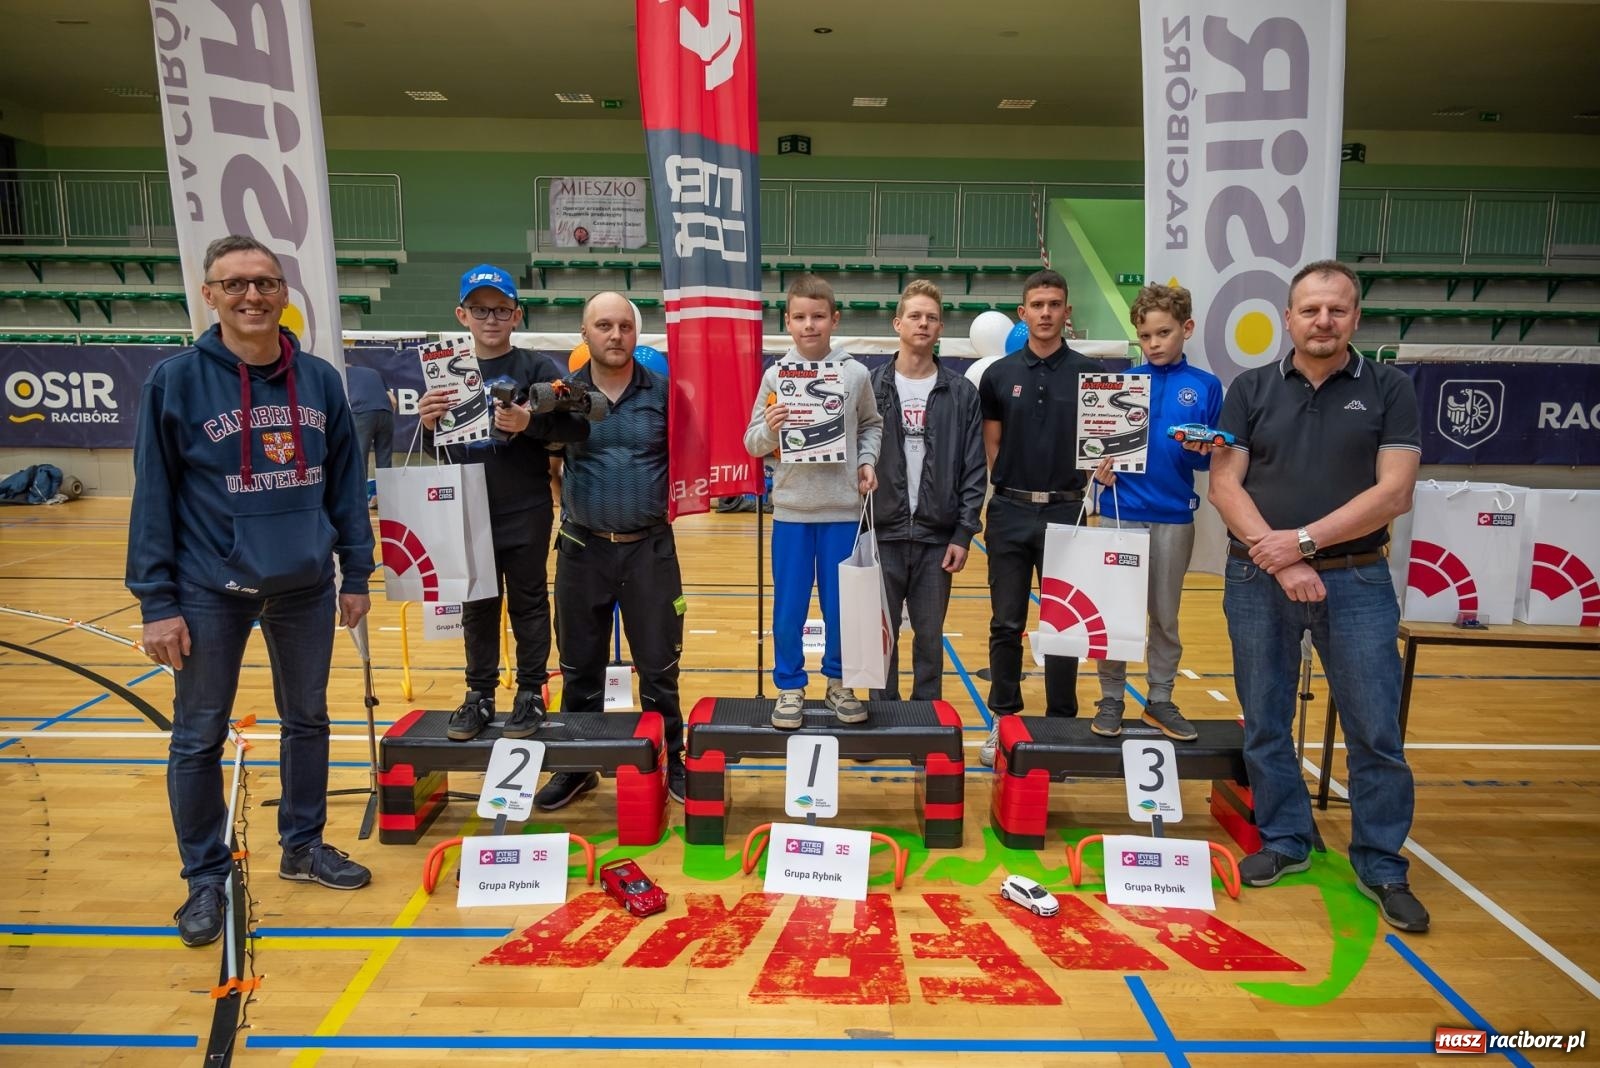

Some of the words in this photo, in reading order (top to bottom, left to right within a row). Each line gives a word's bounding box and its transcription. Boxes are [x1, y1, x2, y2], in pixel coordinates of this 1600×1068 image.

[561, 181, 636, 197] MIESZKO
[5, 371, 118, 409] OSiR
[51, 410, 120, 423] RACIBÓRZ
[494, 747, 531, 791] 2
[807, 744, 822, 787] 1
[1139, 747, 1165, 792] 3
[801, 841, 822, 849] INTER
[784, 869, 810, 880] Grupa
[812, 871, 843, 883] Rybnik
[478, 881, 507, 892] Grupa
[509, 879, 540, 892] Rybnik
[1124, 882, 1152, 894] Grupa
[1154, 883, 1186, 895] Rybnik
